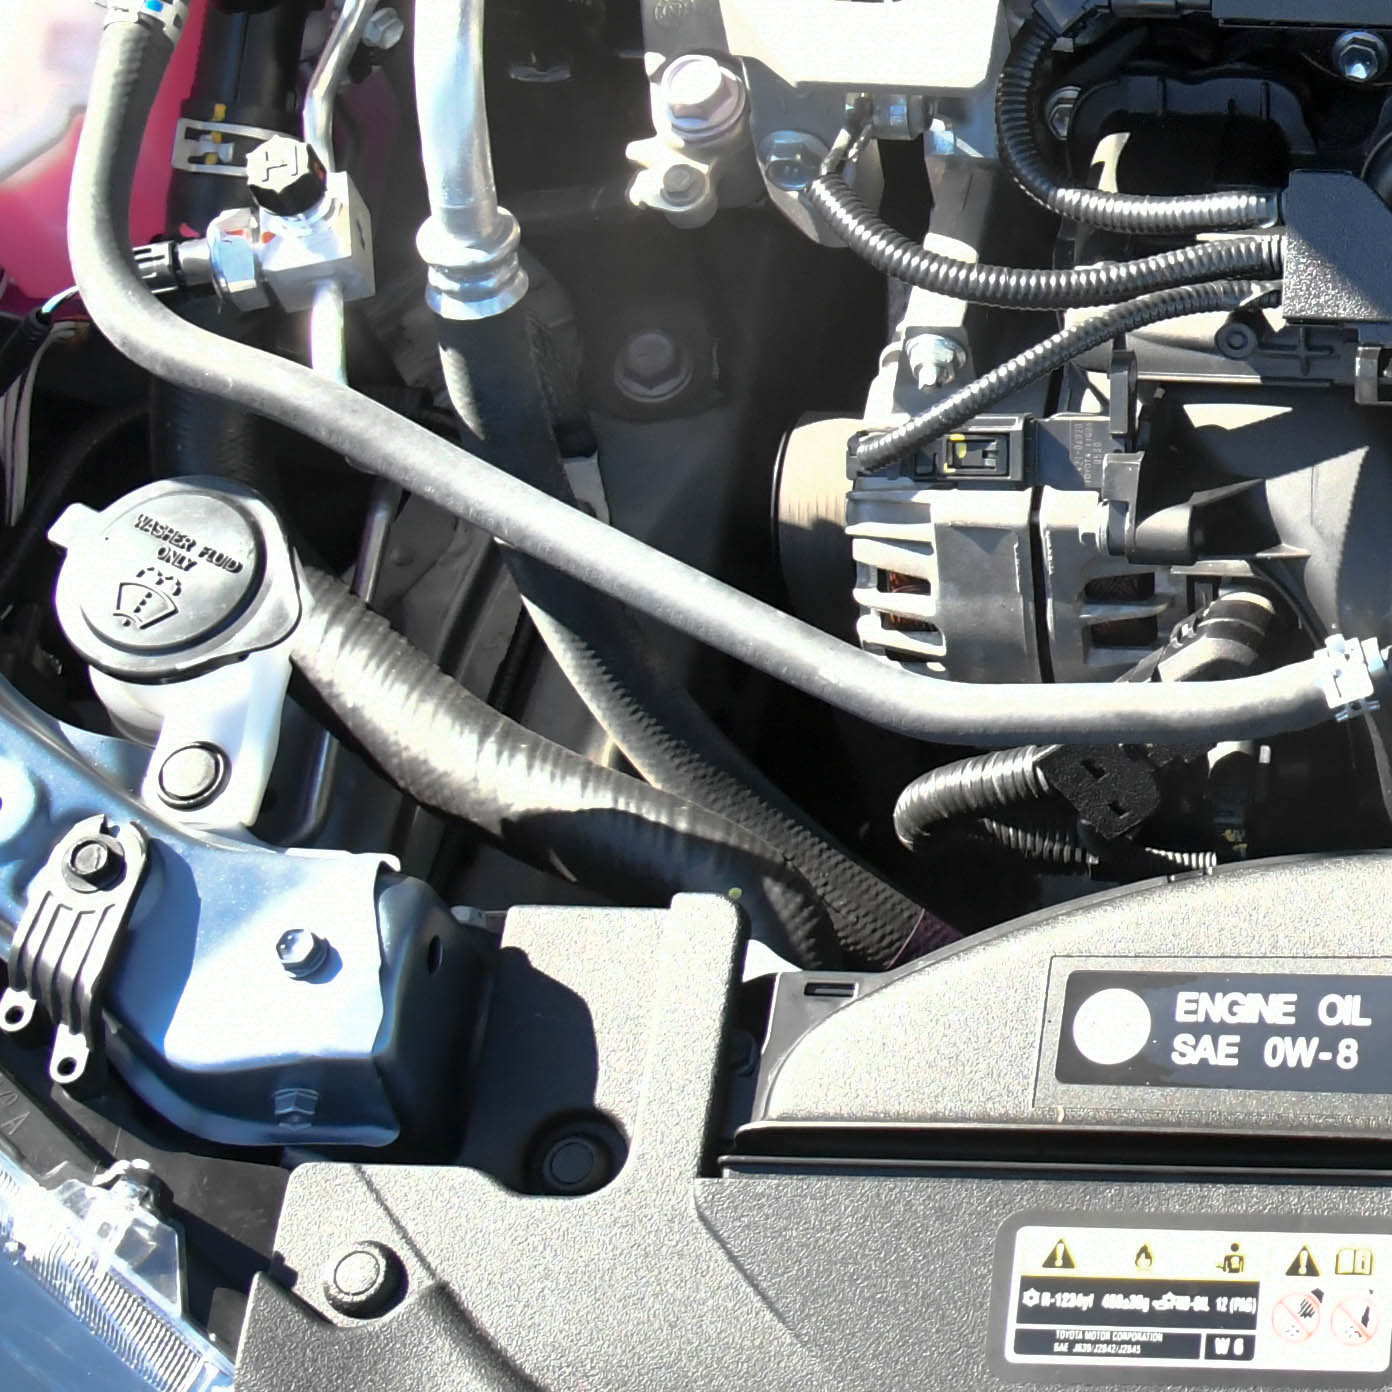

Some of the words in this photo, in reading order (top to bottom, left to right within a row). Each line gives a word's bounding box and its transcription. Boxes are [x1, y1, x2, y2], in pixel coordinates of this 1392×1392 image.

[134, 513, 197, 552] WASHER
[198, 546, 243, 574] FLUID
[157, 547, 198, 571] ONLY
[1175, 991, 1298, 1025] ENGINE
[1317, 993, 1372, 1026] OIL
[1171, 1033, 1241, 1066] SAE
[1056, 1329, 1083, 1340] TOYOTA
[1085, 1330, 1111, 1341] MOTOR
[1112, 1331, 1163, 1343] CORPORATION
